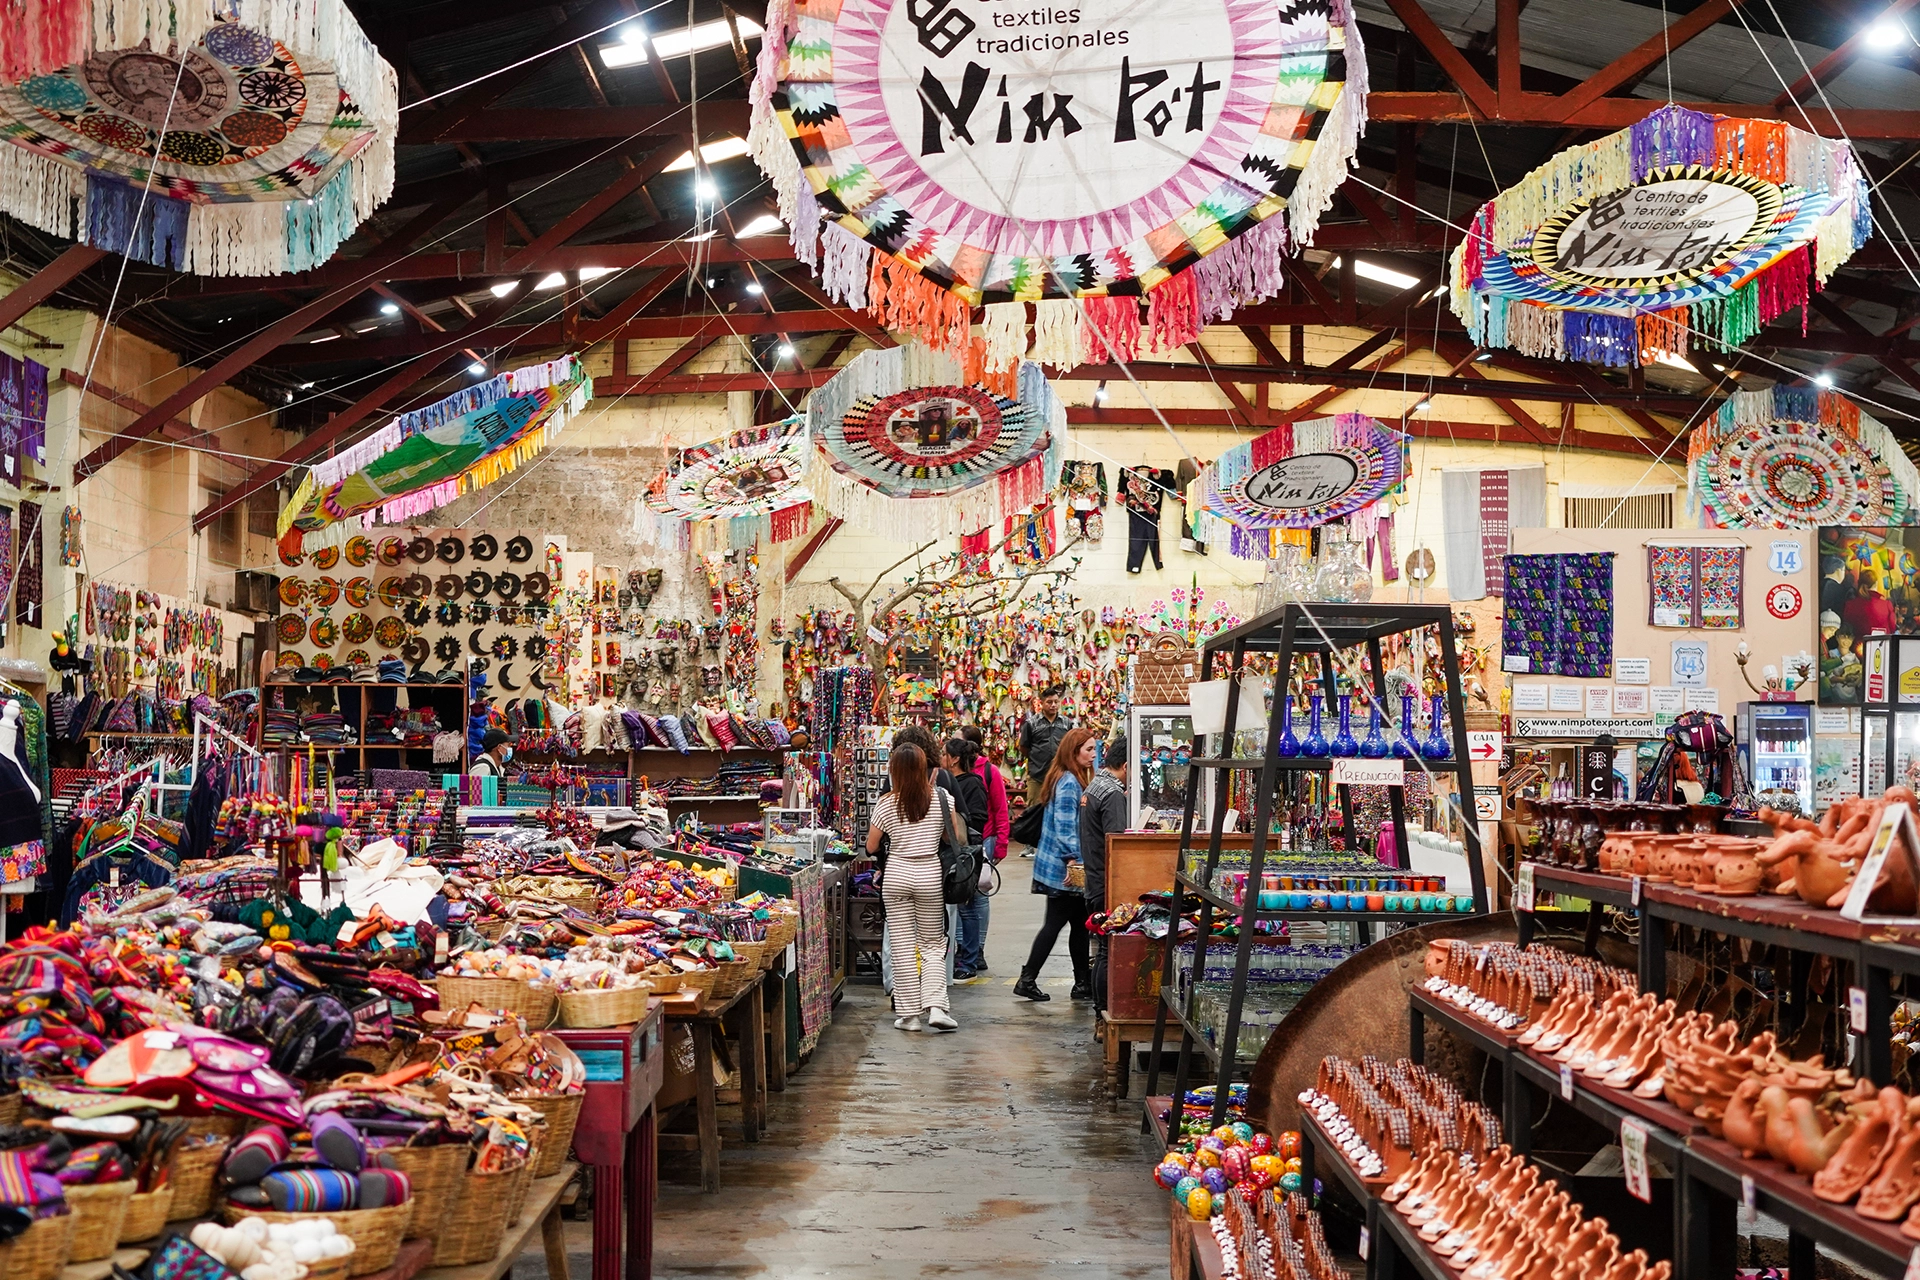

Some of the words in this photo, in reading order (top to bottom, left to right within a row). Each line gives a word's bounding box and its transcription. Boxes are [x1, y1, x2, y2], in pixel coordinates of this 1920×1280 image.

[993, 7, 1081, 28] textiles
[976, 29, 1129, 54] tradicionales
[916, 61, 1083, 157] Nim
[1634, 189, 1685, 204] Centro
[1687, 191, 1708, 204] de
[1633, 205, 1687, 217] textiles
[1619, 218, 1715, 230] tradicionales
[1550, 229, 1651, 272] Nim
[1256, 481, 1302, 500] Nim
[1776, 551, 1796, 569] 14
[1681, 656, 1697, 672] 14
[1532, 718, 1652, 728] www.nimpotexport.com
[1473, 734, 1494, 742] CAJA
[1532, 728, 1548, 736] Buy
